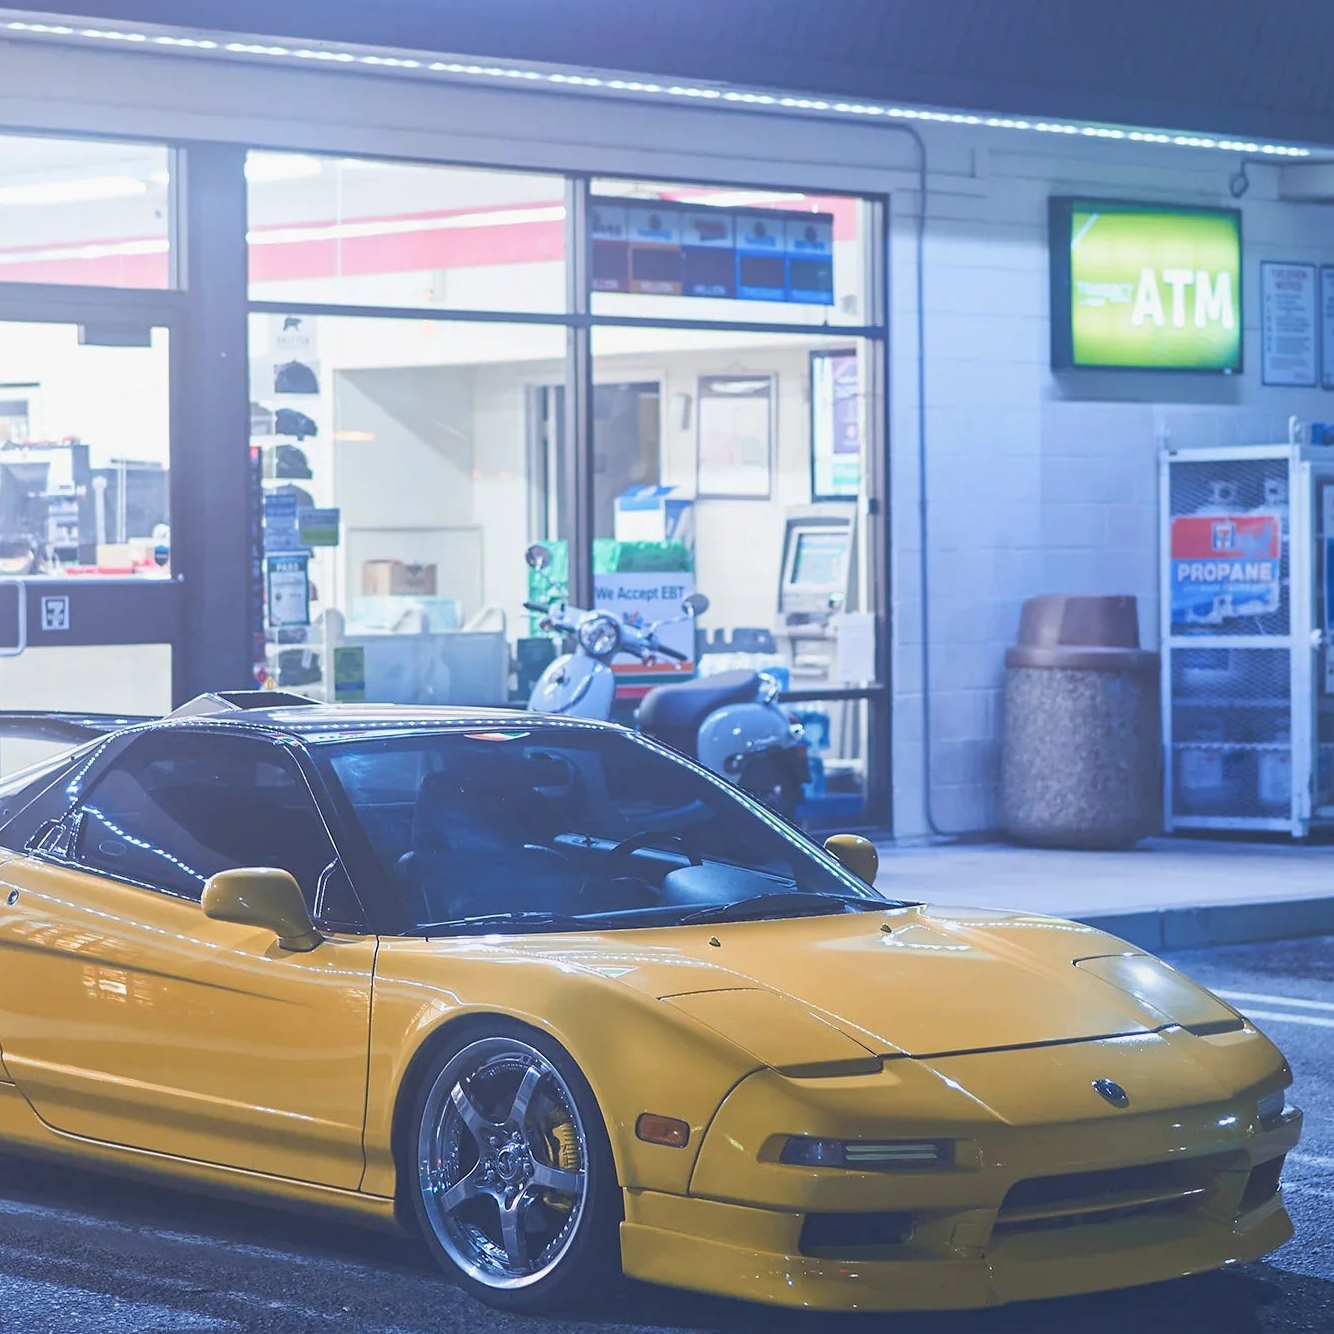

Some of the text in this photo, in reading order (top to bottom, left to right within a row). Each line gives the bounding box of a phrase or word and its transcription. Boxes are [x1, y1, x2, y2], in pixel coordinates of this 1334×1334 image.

[1131, 267, 1235, 331] ATM
[1177, 563, 1273, 582] PROPANE
[595, 586, 684, 601] We Accept EBT
